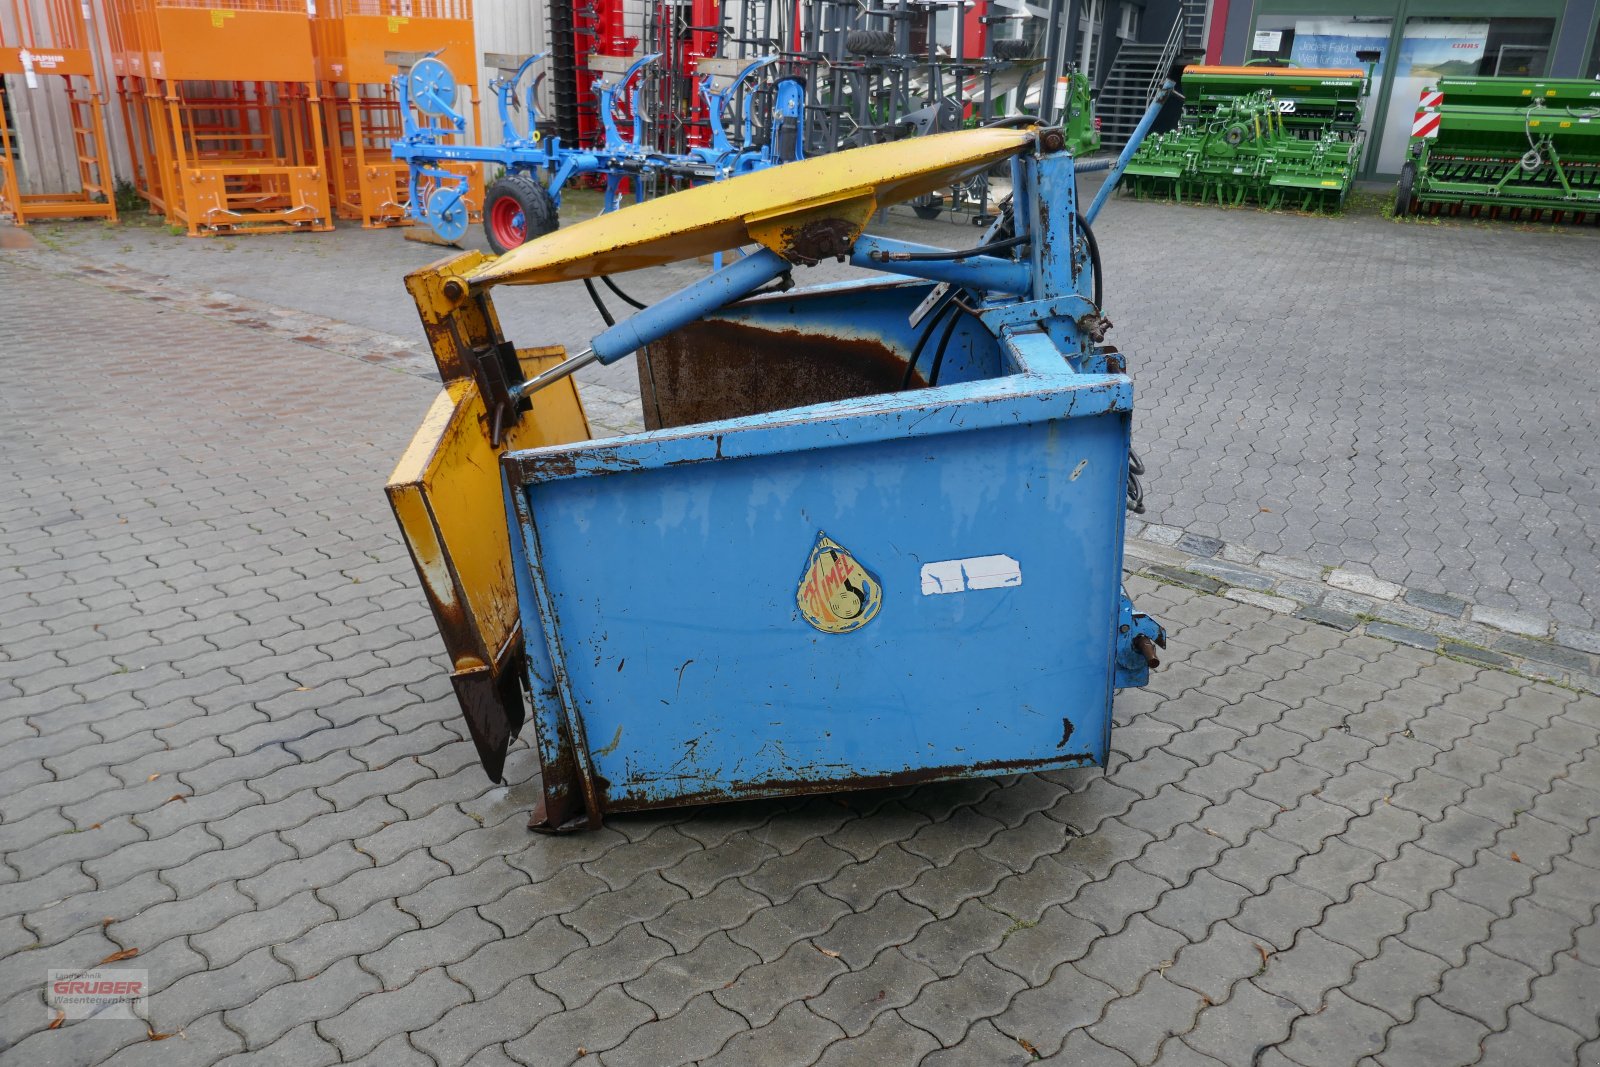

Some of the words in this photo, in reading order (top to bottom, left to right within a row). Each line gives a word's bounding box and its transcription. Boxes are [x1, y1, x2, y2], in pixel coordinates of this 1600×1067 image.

[1299, 41, 1327, 51] Jedes
[1329, 42, 1349, 52] Feld
[1351, 43, 1362, 53] ist
[1298, 53, 1317, 63] Welt
